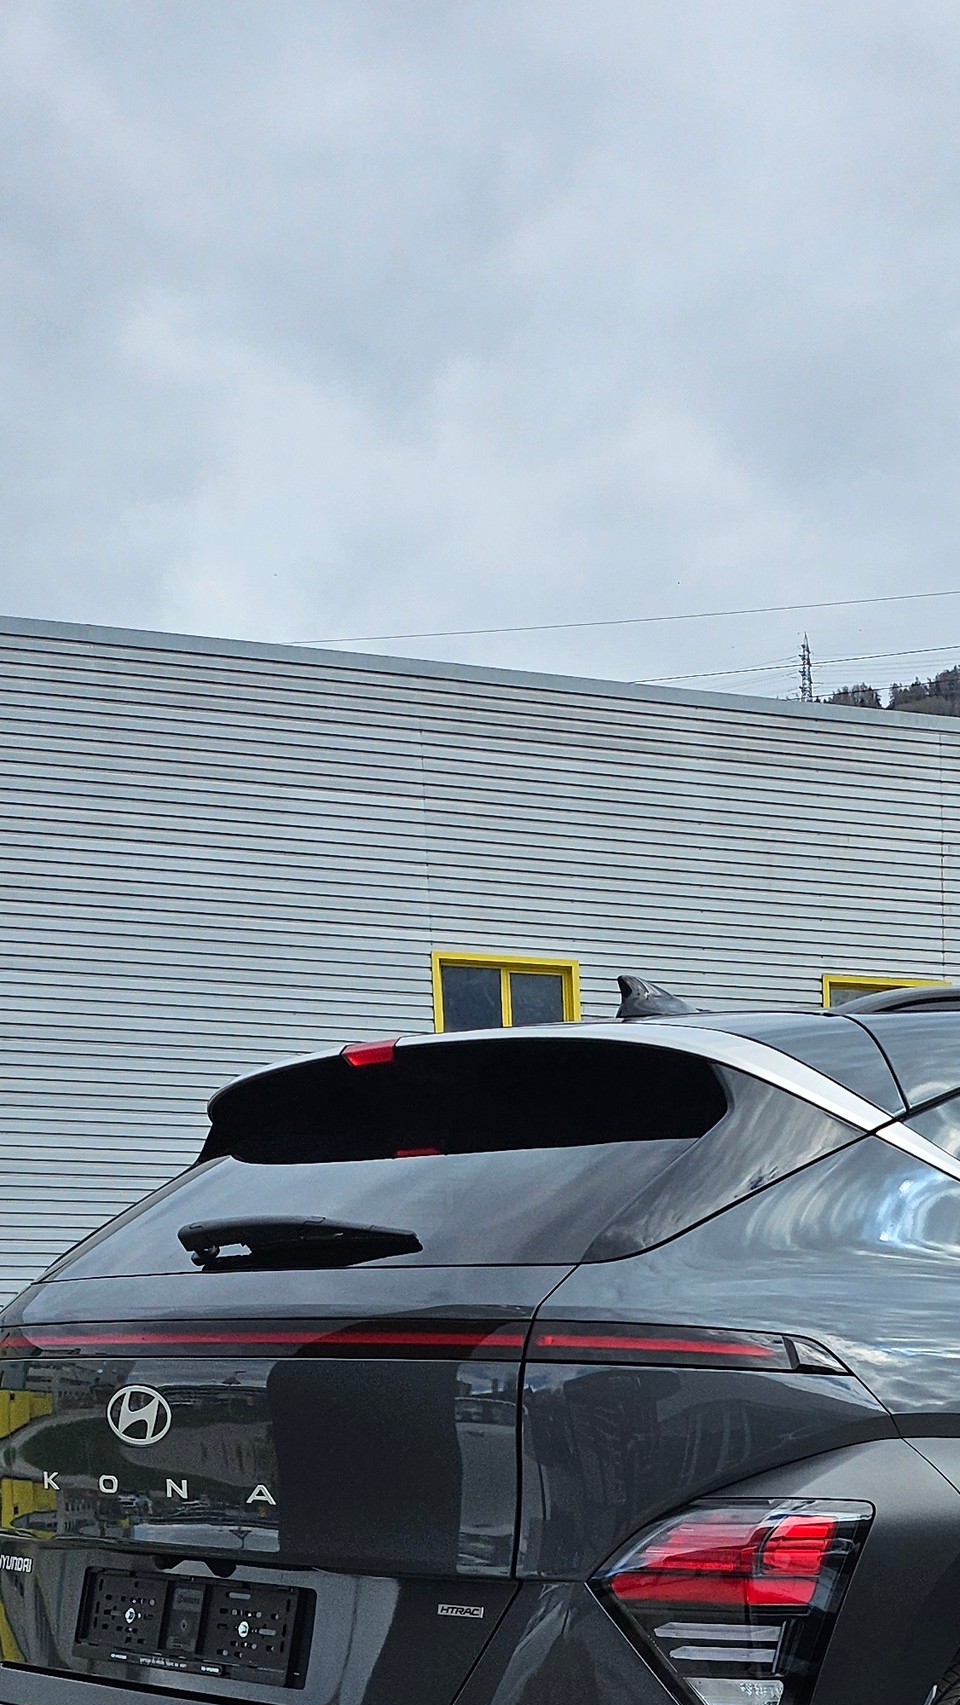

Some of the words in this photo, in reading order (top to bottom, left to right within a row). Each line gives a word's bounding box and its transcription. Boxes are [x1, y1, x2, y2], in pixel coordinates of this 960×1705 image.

[43, 1471, 277, 1506] KONA
[0, 1554, 33, 1573] YUNDAI
[439, 1604, 481, 1617] HTRAC
